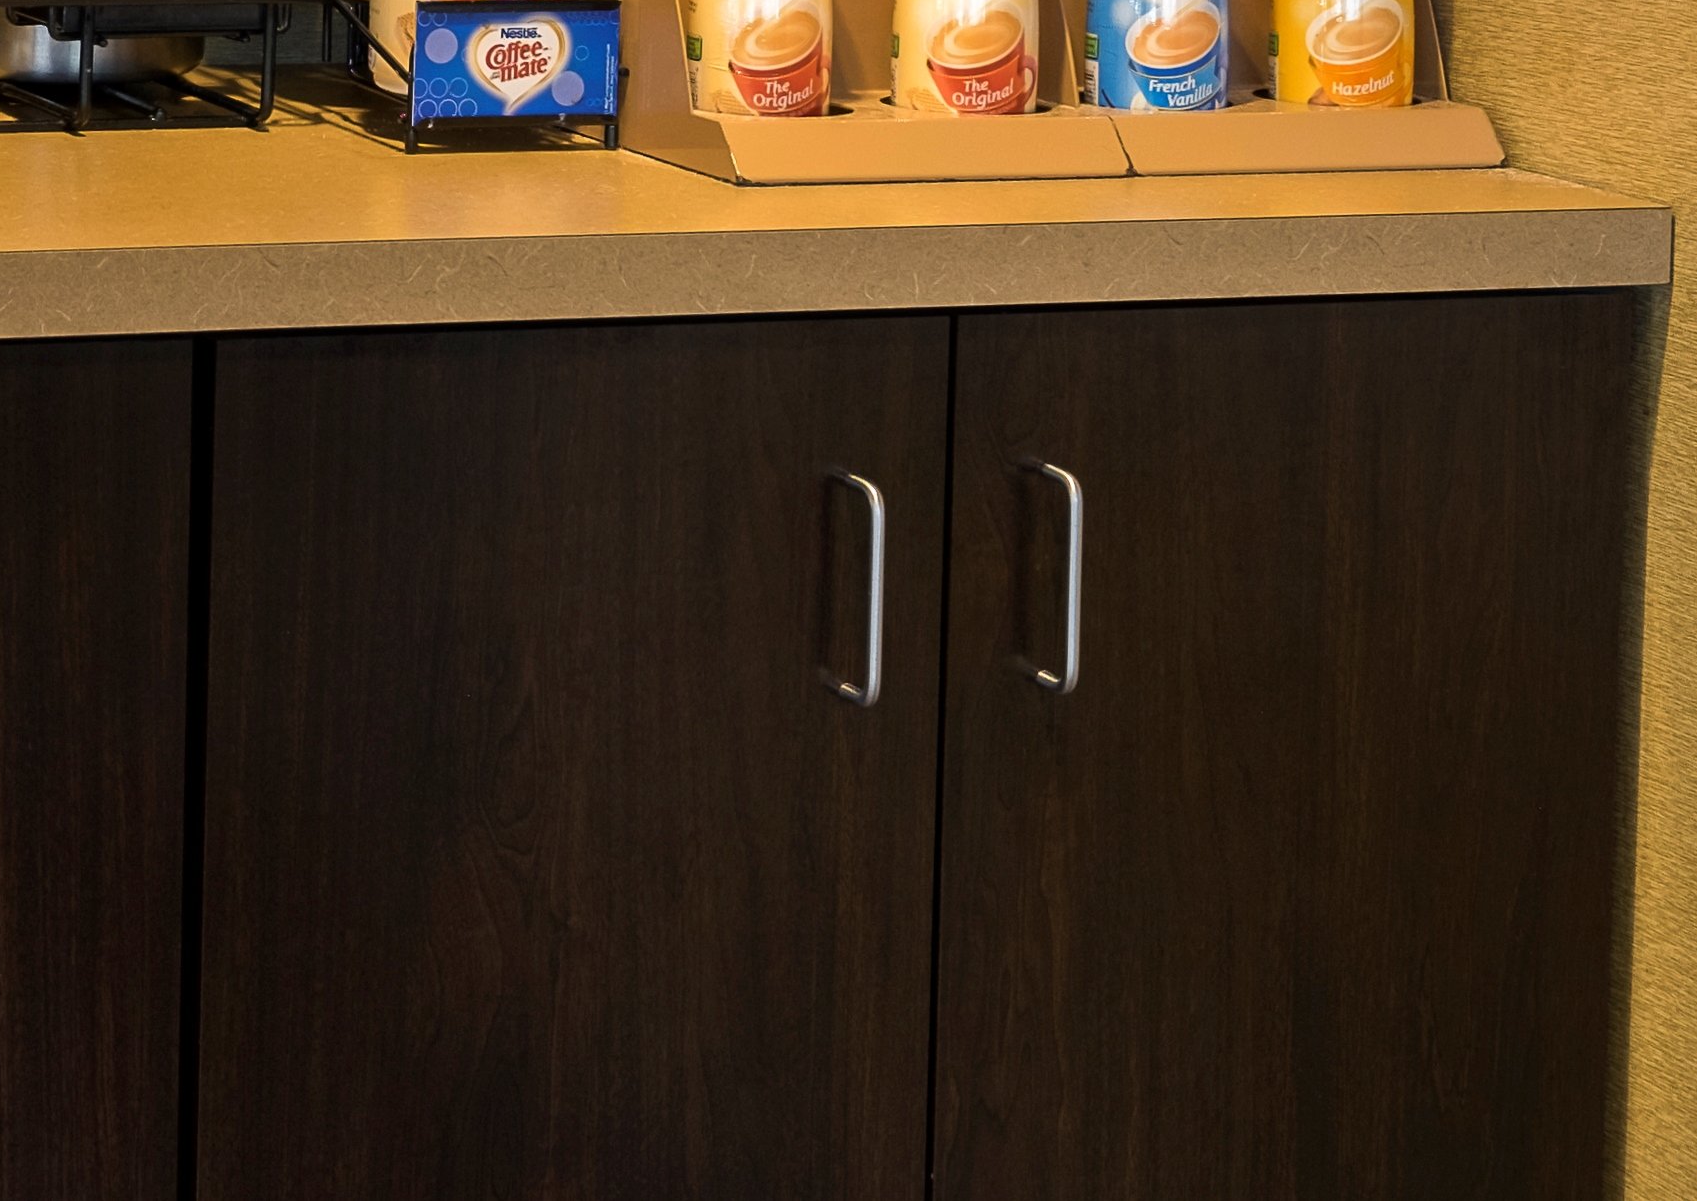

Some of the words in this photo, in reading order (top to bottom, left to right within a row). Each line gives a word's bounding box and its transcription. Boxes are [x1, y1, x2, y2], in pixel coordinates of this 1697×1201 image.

[500, 57, 548, 83] mate
[753, 78, 813, 110] Original
[765, 80, 790, 95] The
[952, 77, 1014, 110] Original
[963, 78, 989, 92] The
[1148, 75, 1196, 93] French
[1167, 83, 1213, 107] Vanilla
[1332, 70, 1395, 96] Hazelnut
